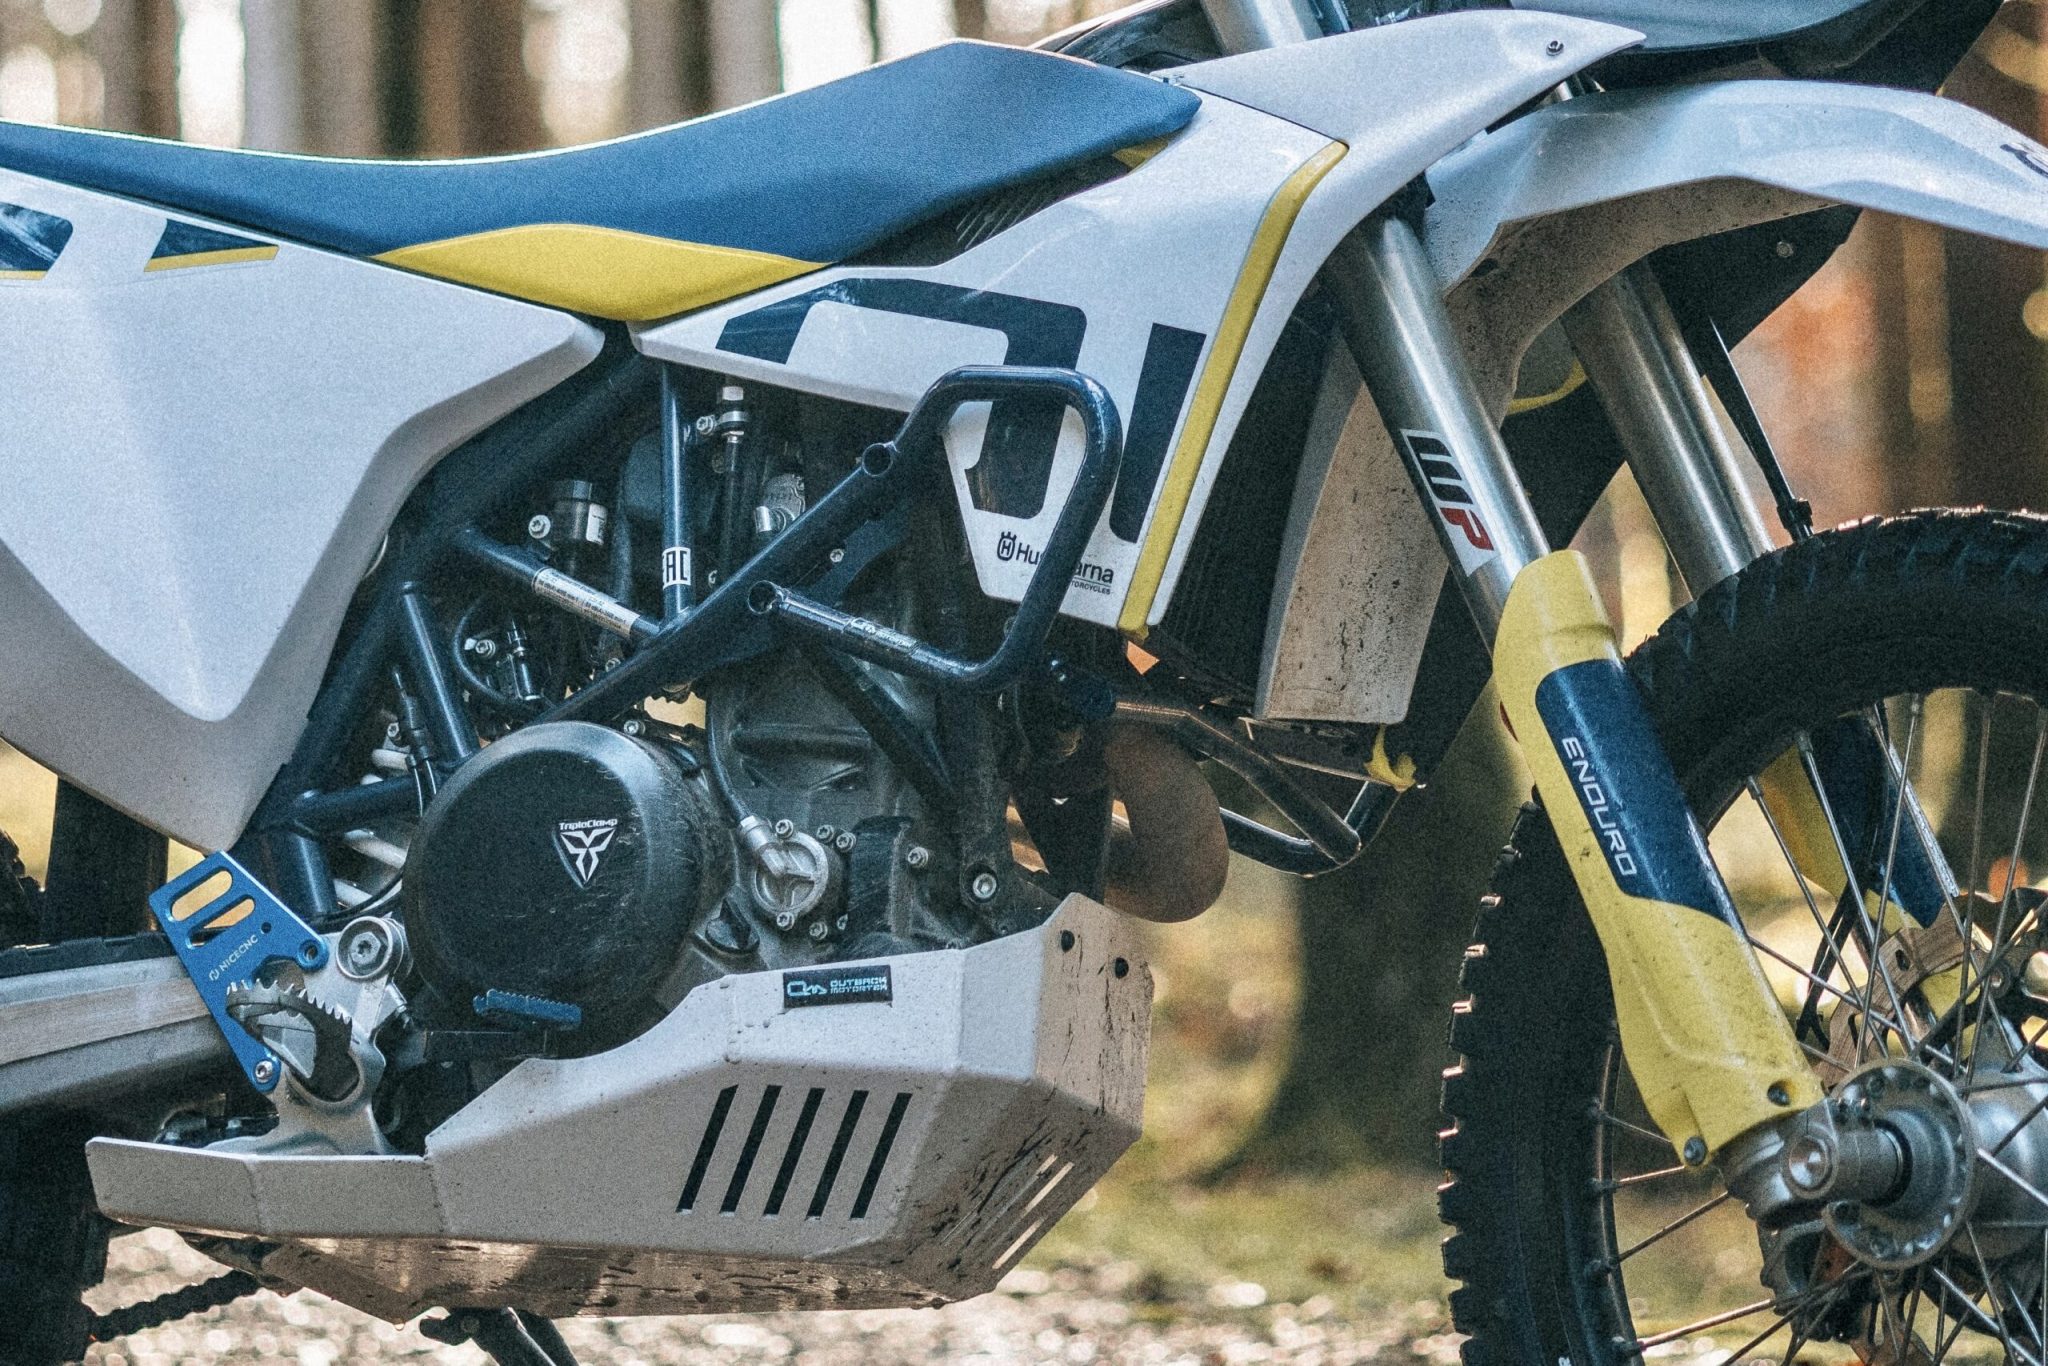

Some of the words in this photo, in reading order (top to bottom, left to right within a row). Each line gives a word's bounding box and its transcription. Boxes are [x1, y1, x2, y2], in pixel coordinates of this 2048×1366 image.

[1071, 580, 1111, 595] TORCYCLES
[1562, 736, 1638, 876] ENDURO
[219, 934, 259, 972] NICECNC
[830, 976, 887, 987] OUTBACK
